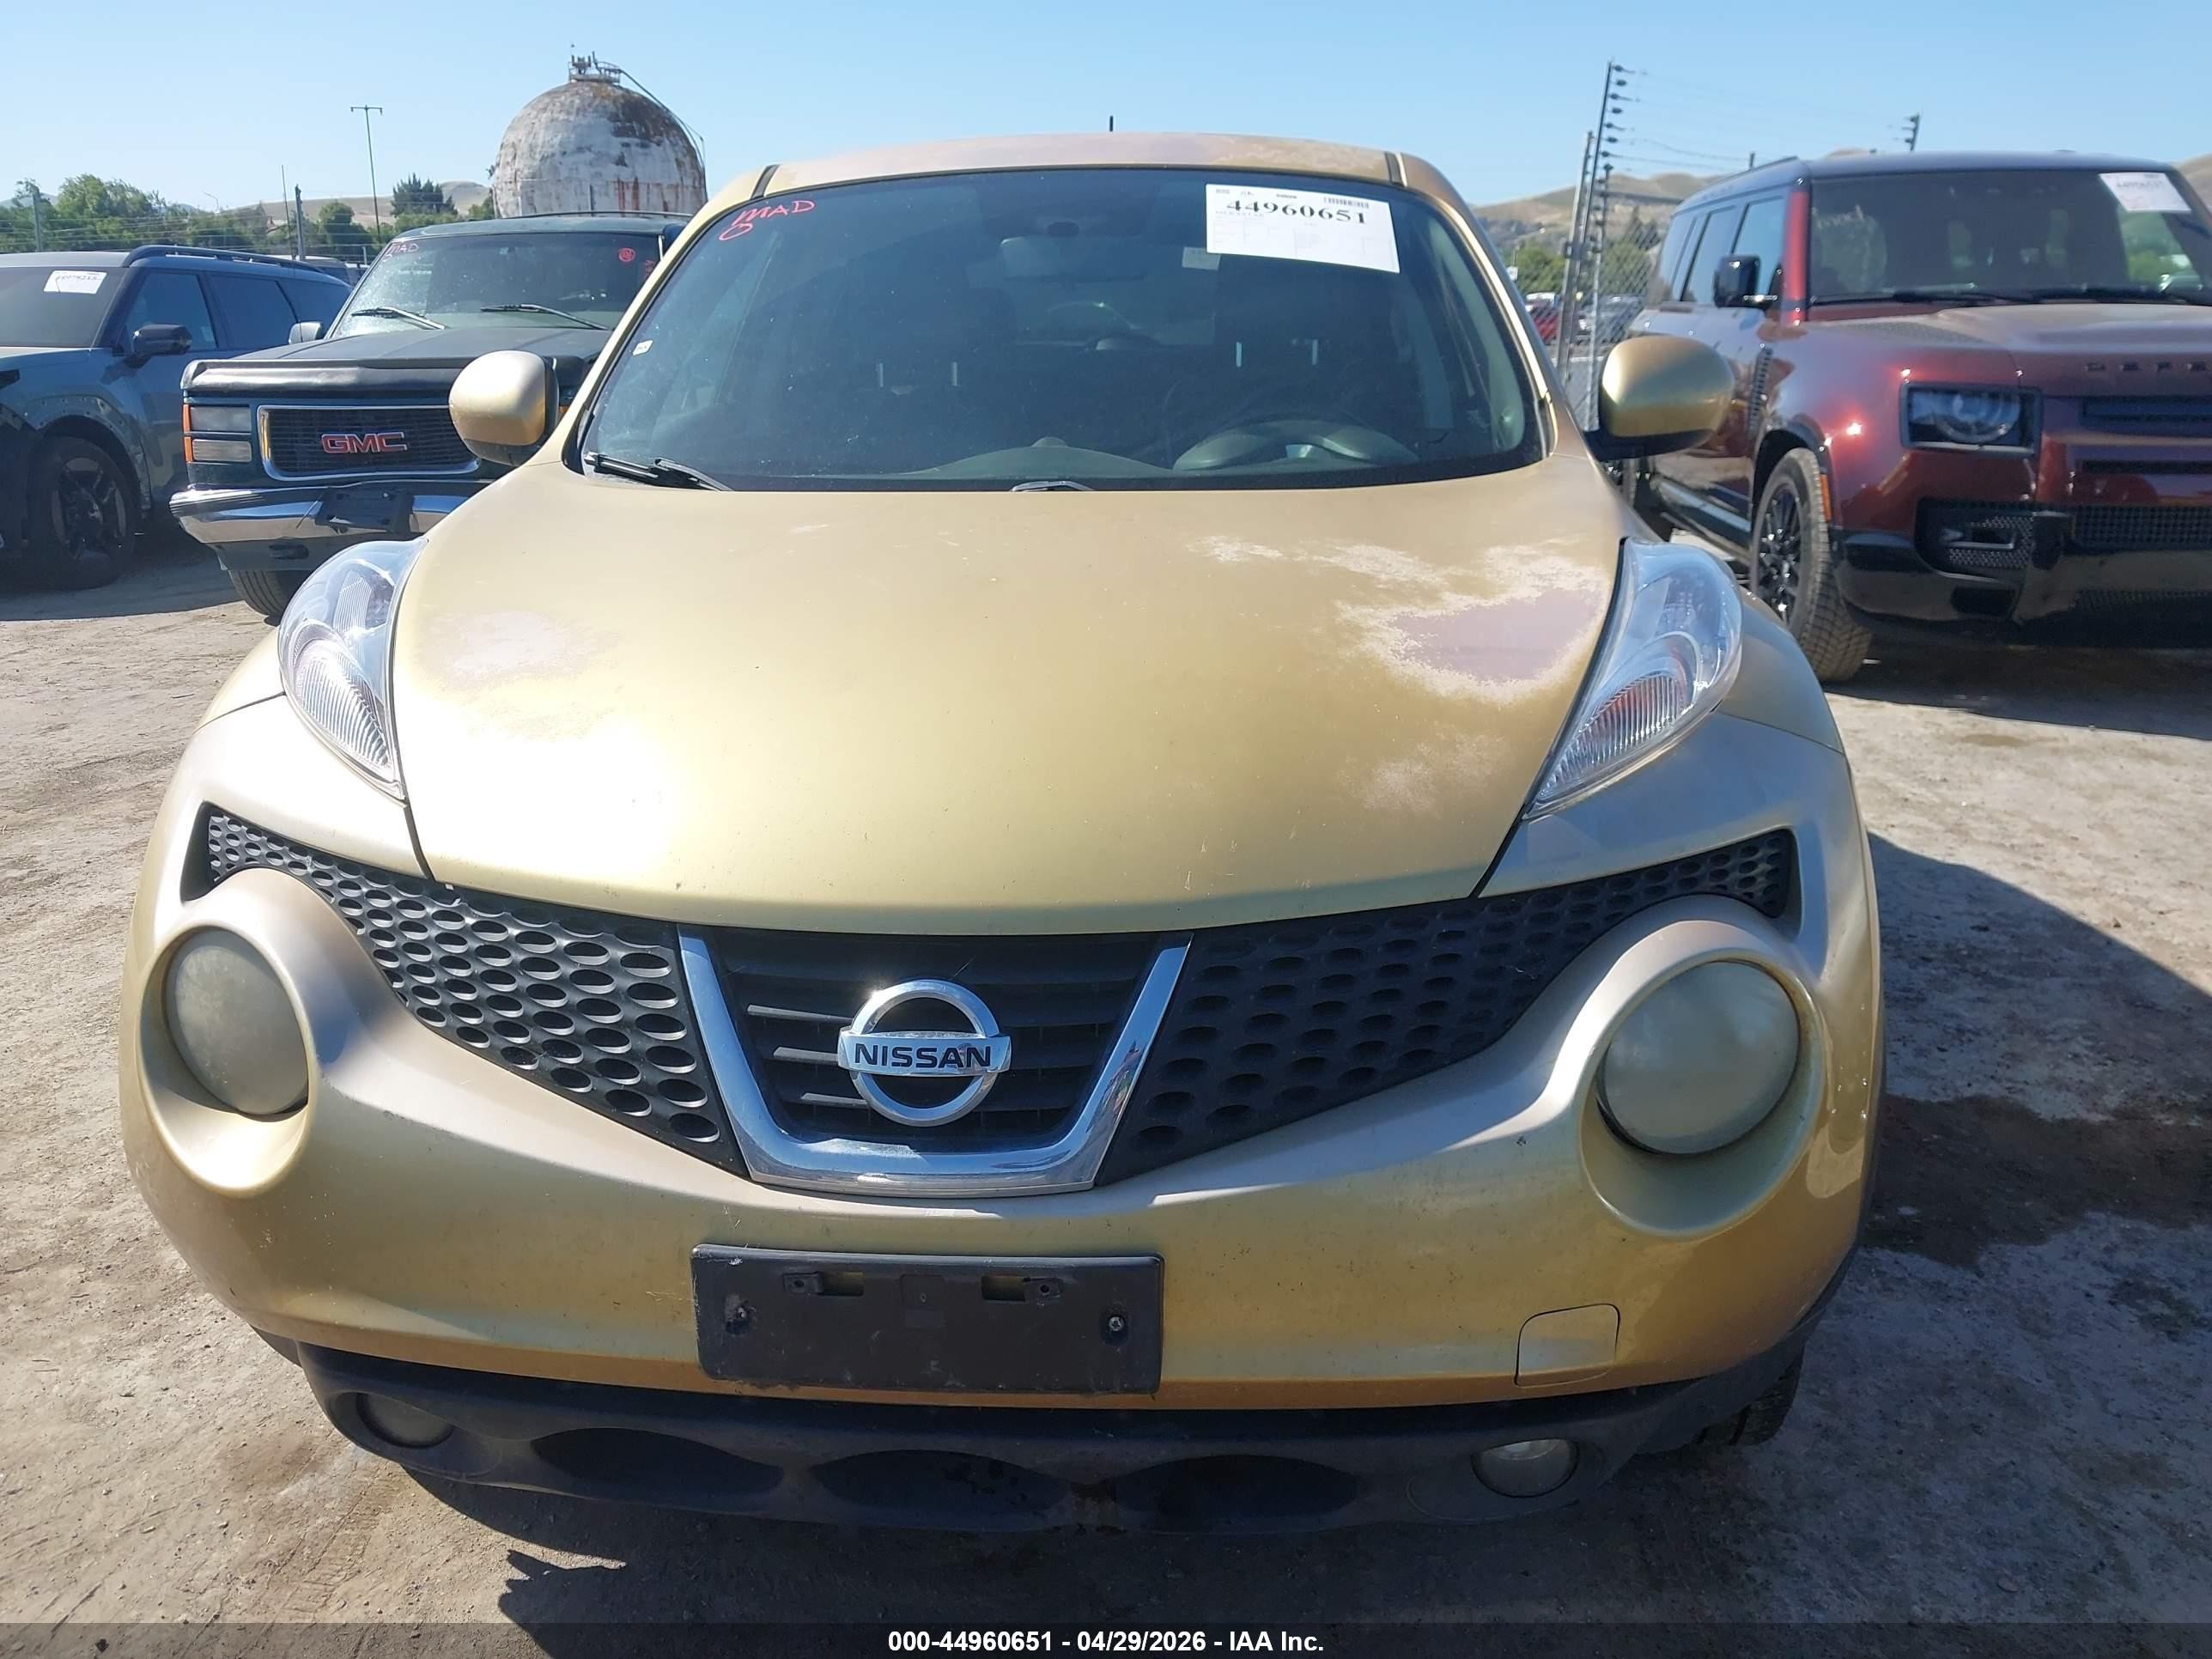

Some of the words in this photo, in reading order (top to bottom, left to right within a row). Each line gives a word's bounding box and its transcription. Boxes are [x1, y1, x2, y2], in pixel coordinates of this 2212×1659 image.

[1226, 199, 1365, 224] 44960651
[321, 432, 408, 453] GMC
[854, 1042, 992, 1069] NISSAN
